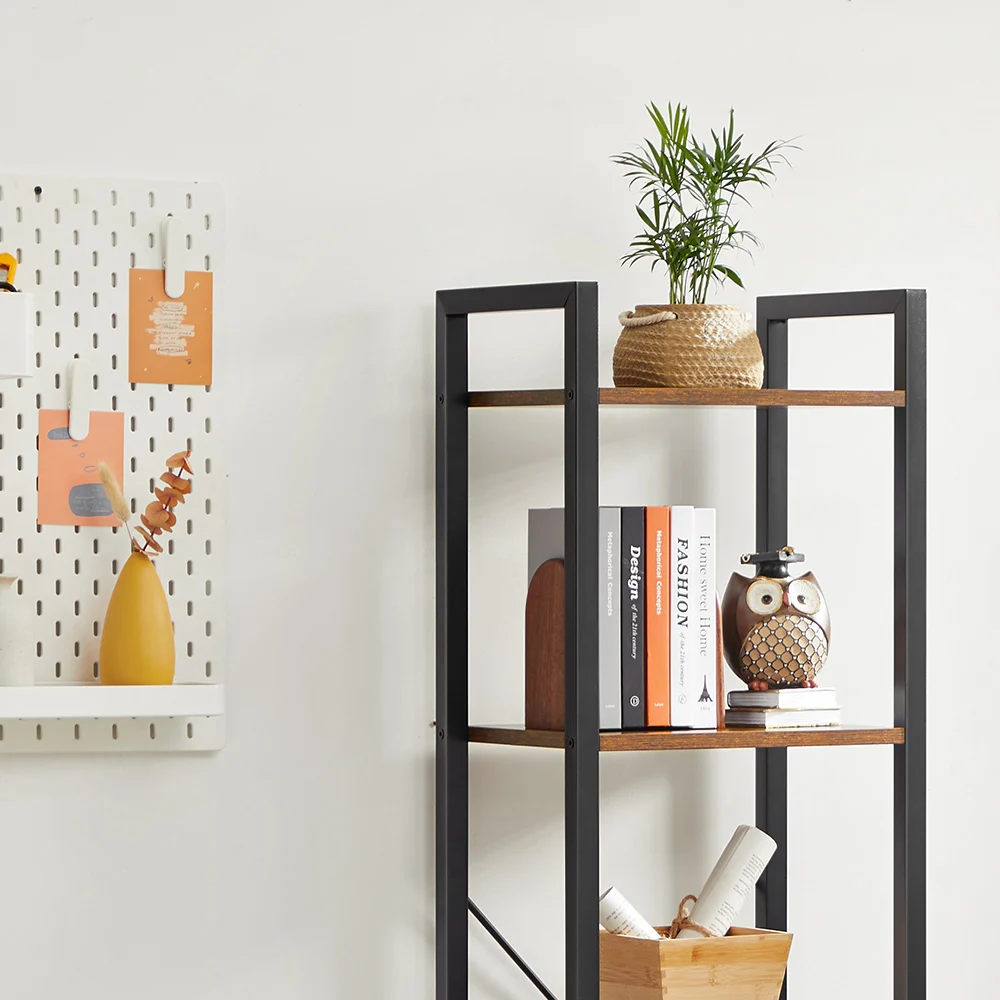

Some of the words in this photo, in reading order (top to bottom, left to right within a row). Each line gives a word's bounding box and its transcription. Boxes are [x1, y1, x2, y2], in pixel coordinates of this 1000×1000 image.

[628, 545, 641, 600] Design
[700, 535, 711, 575] Home
[677, 538, 688, 628] FASHION
[700, 579, 708, 612] sweet
[631, 603, 638, 612] of
[700, 617, 711, 657] Home
